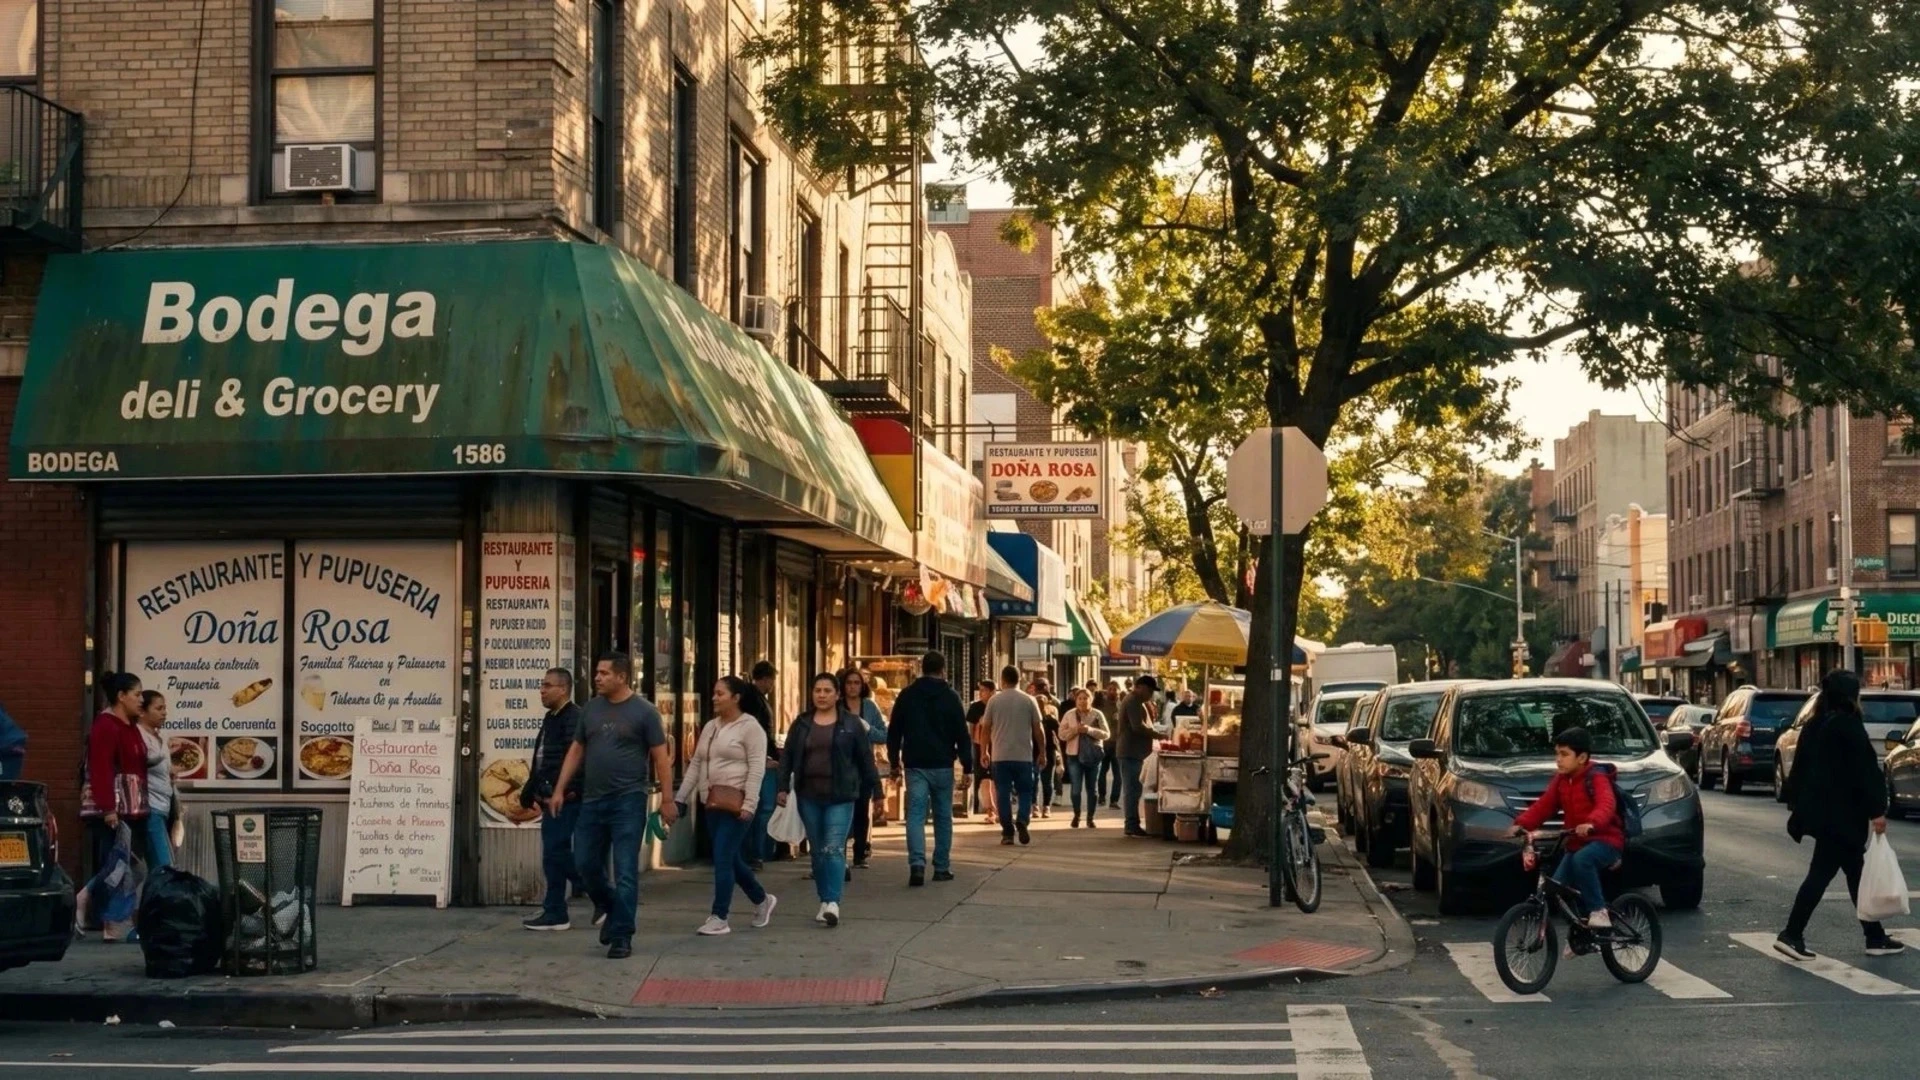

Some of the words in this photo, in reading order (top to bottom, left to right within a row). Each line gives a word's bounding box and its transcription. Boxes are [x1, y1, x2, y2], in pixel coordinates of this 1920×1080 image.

[141, 278, 437, 356] Bodega
[121, 379, 201, 419] deli
[214, 378, 246, 417] &
[263, 377, 440, 423] Grocery
[452, 444, 506, 465] 1586
[989, 448, 1043, 457] RESTAURANTE
[1046, 448, 1052, 456] Y
[1054, 448, 1098, 457] PUPUSERIA
[28, 451, 119, 473] BODEGA
[991, 459, 1042, 477] DOÑA
[1048, 463, 1096, 477] ROSA
[484, 542, 553, 556] RESTAURANTE
[515, 560, 522, 572] Y
[137, 553, 283, 620] RESTAURANTE
[299, 553, 313, 579] Y
[319, 554, 441, 620] PUPUSERIA
[485, 576, 550, 590] PUPUSERIA
[486, 599, 549, 610] RESTAURANTA
[184, 610, 279, 644] Doña
[302, 609, 391, 651] Rosa
[205, 717, 218, 730] de
[360, 738, 438, 755] Restaurante
[369, 759, 401, 775] Doña
[409, 759, 441, 775] Rosa
[399, 798, 410, 809] de
